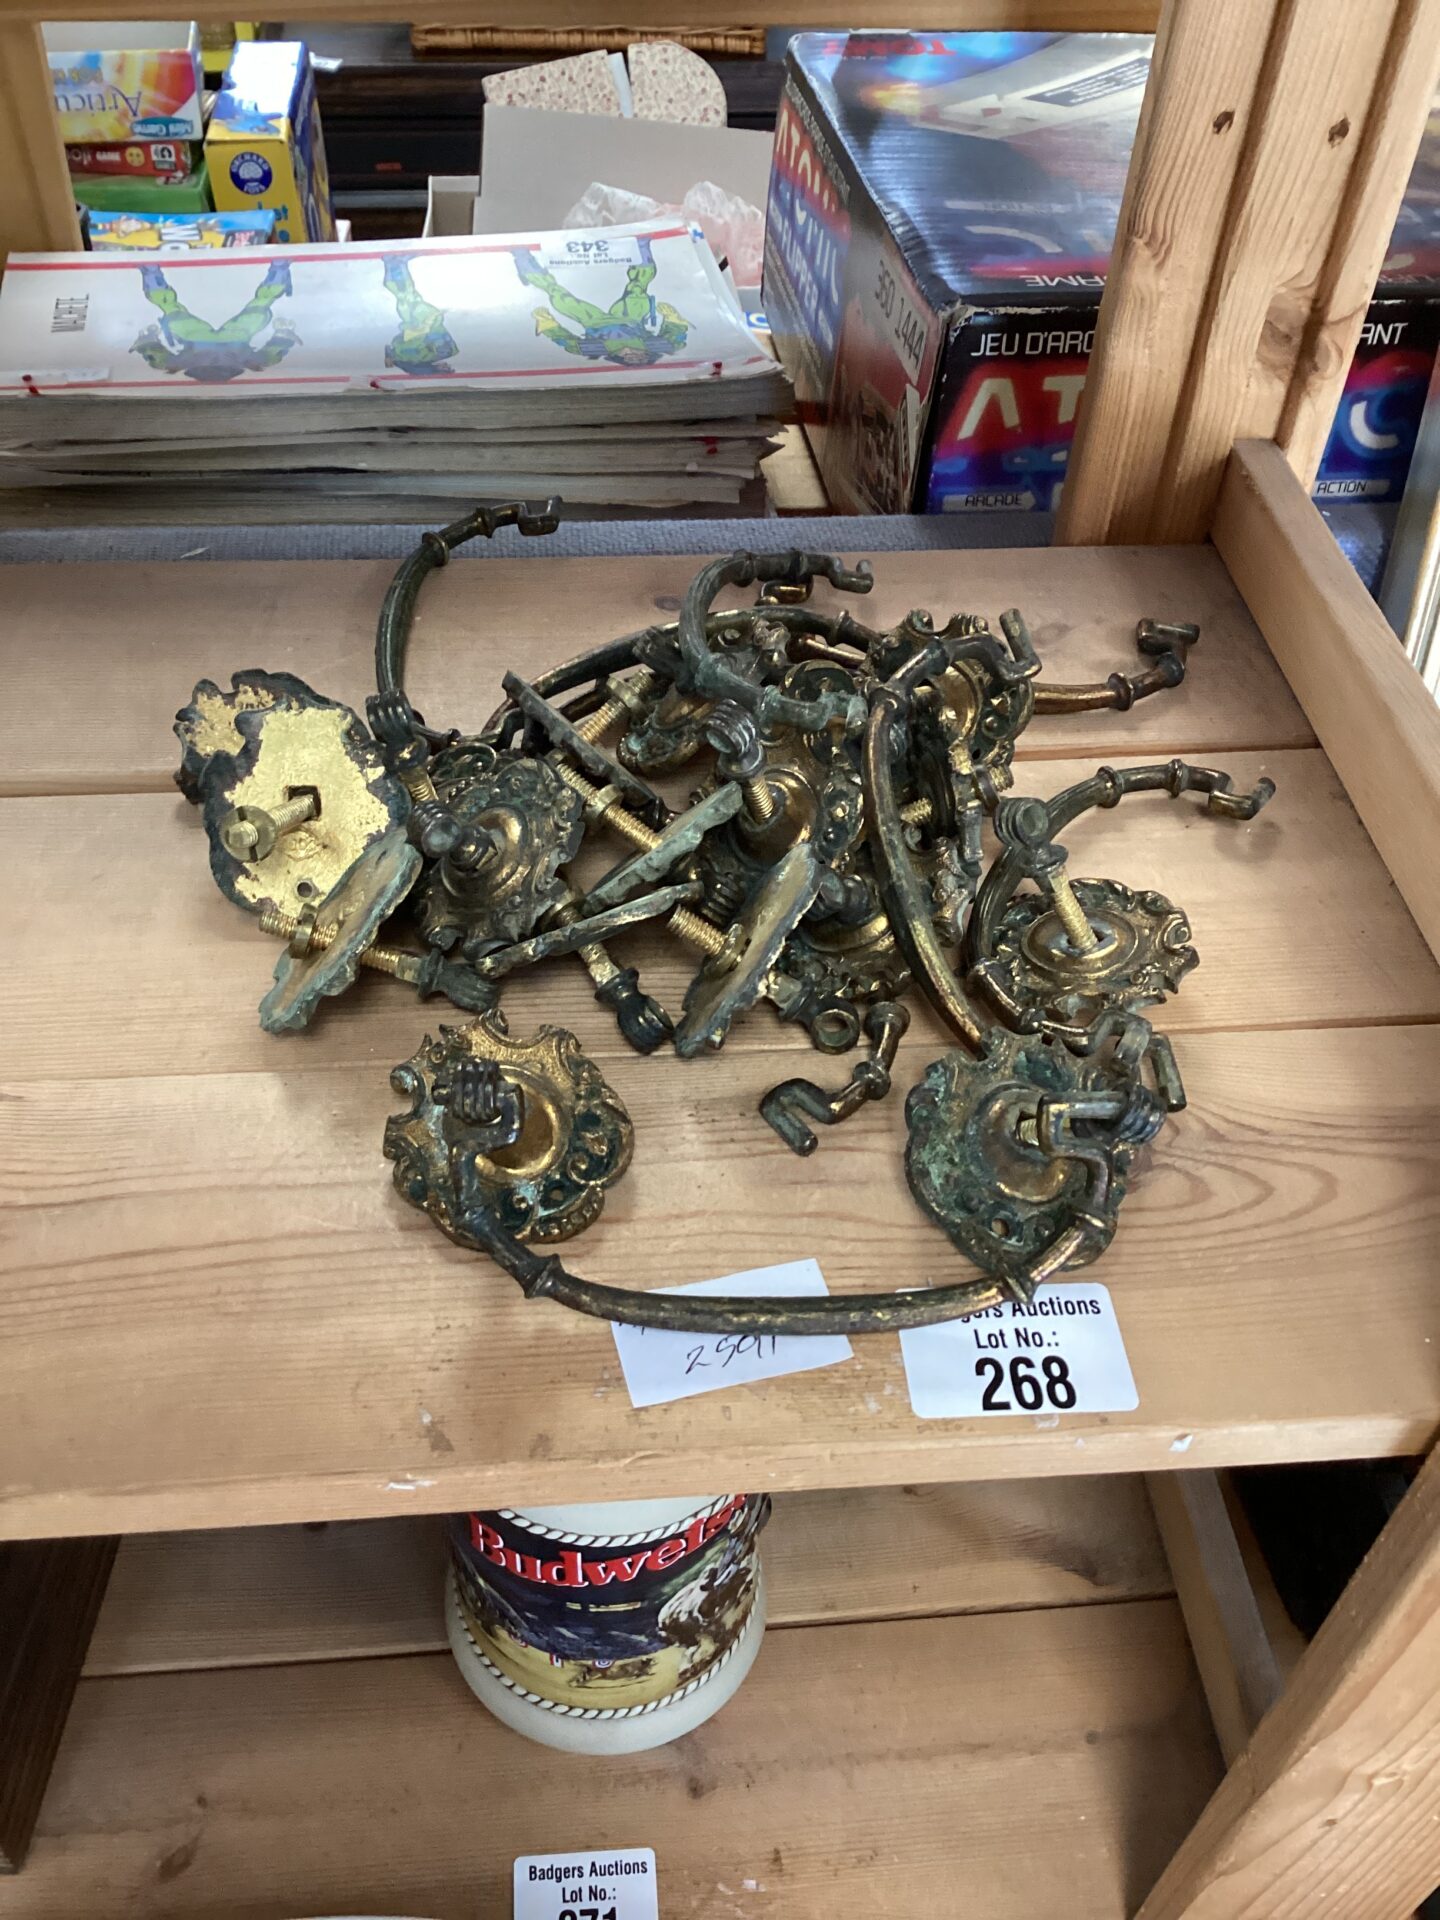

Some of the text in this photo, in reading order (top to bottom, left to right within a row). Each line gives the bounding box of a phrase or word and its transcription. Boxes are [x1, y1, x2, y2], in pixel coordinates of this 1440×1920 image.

[566, 240, 609, 253] 343
[1020, 274, 1106, 287] AME
[971, 333, 1020, 356] JEU
[1317, 480, 1367, 494] ACTION
[964, 494, 1023, 507] ARCADE
[1012, 1296, 1102, 1317] Auctions
[974, 1329, 1008, 1349] Lot
[975, 1355, 1077, 1411] 268
[529, 1859, 648, 1883] Badgers Auctions
[562, 1886, 583, 1903] Lot
